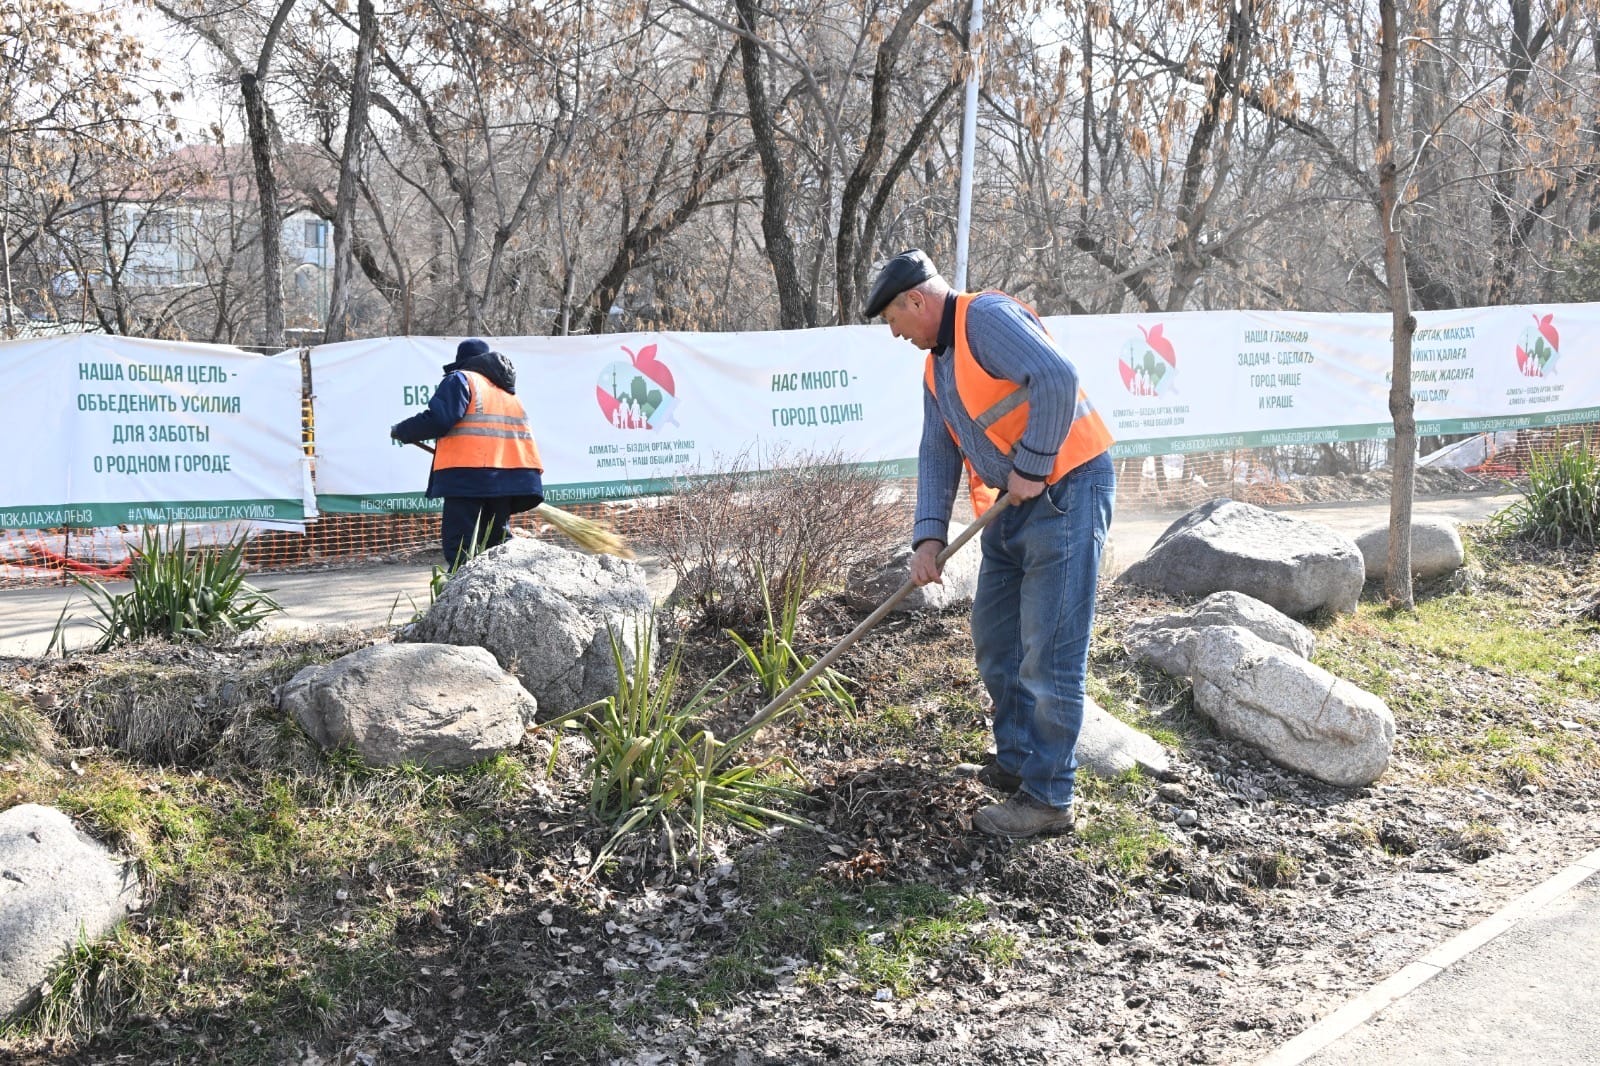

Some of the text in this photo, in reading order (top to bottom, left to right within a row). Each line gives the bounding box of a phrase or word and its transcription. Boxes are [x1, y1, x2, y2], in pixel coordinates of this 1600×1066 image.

[1244, 330, 1309, 343] НАША ГЛАВНАЯ
[1238, 352, 1270, 366] ЗАДАЧА
[1277, 351, 1315, 365] СДЕЛАТЬ
[78, 362, 124, 381] НАША
[128, 364, 183, 384] ОБЩАЯ
[187, 365, 227, 385] ЦЕЛЬ
[771, 372, 797, 392] НАС
[800, 369, 849, 391] МНОГО
[1251, 372, 1301, 388] ГОРОД ЧИЩЕ
[77, 393, 241, 414] ОБЪЕДЕНИТЬ УСИЛИЯ
[403, 385, 429, 406] БІЗ
[1258, 395, 1295, 410] И КРАШЕ
[772, 403, 864, 427] ГОРОД ОДИН!
[113, 424, 209, 444] ДЛЯ ЗАБОТЫ
[588, 444, 618, 454] АЛМАТЫ
[94, 455, 231, 475] О РОДНОМ ГОРОДЕ
[596, 457, 626, 468] АЛМАТЫ
[632, 456, 648, 465] НАШ
[649, 454, 674, 465] ОБЩИЙ
[675, 453, 690, 464] ДОМ
